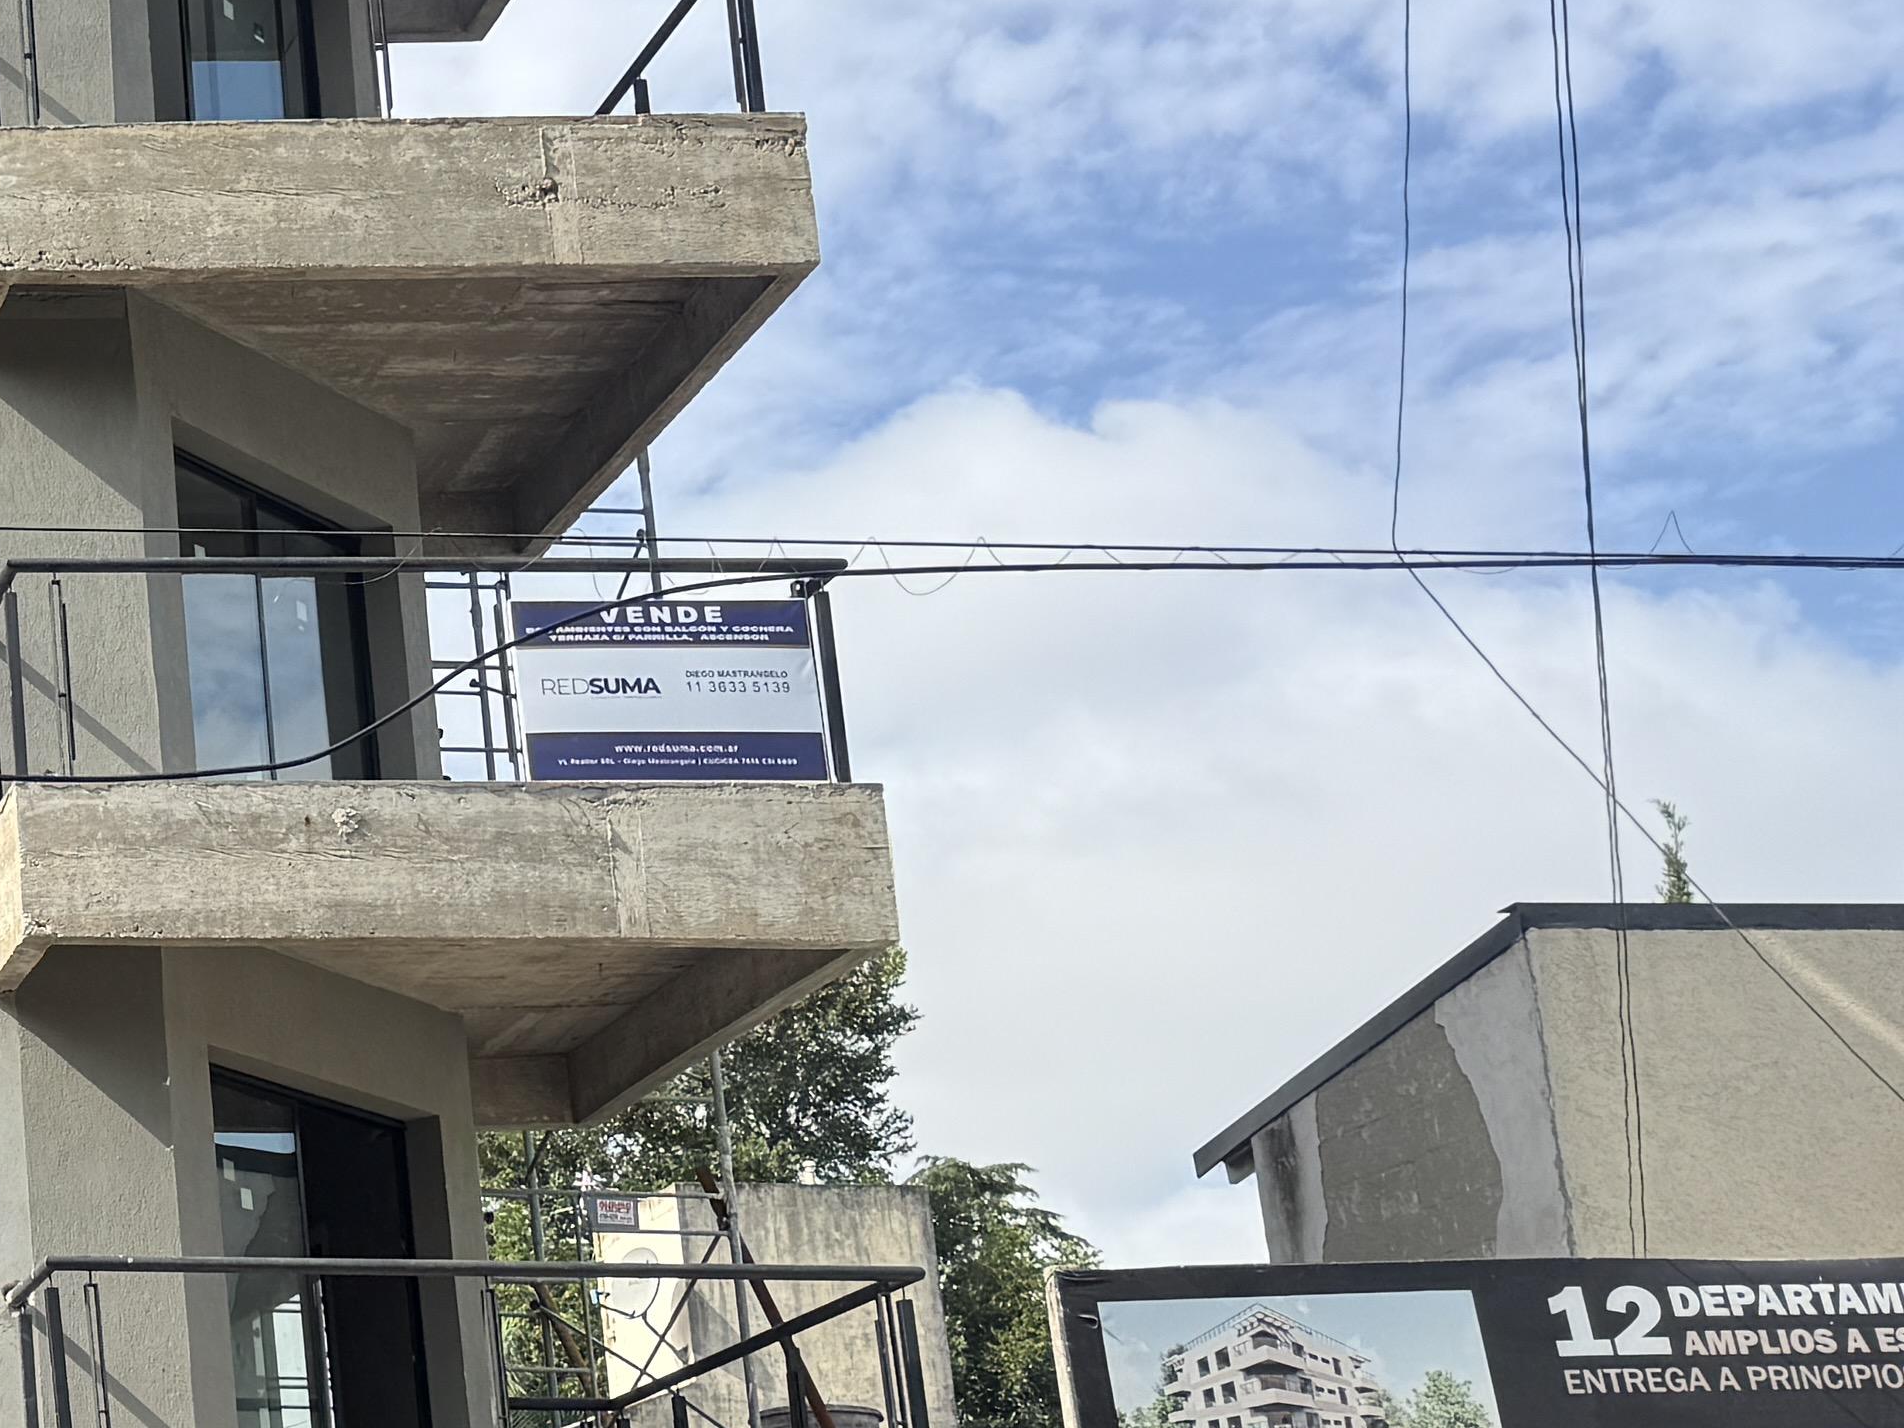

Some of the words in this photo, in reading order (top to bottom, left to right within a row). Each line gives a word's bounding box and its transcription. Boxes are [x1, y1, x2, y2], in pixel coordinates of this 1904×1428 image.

[600, 606, 723, 624] VENDE
[548, 634, 610, 642] TERRAZA
[700, 633, 770, 641] ASCENSOR
[664, 624, 717, 633] BALCÓN
[720, 625, 729, 633] Y
[731, 625, 794, 633] COCHERA
[685, 669, 715, 678] DIEGO
[541, 677, 662, 696] REDSUMA
[687, 681, 701, 693] 11
[708, 680, 747, 693] 3633
[752, 680, 791, 693] 5139
[1666, 1282, 1904, 1318] DEPARTAM
[1547, 1285, 1673, 1358] 12
[1685, 1327, 1838, 1356] AMPLIOS
[1847, 1327, 1872, 1354] A
[1564, 1366, 1712, 1395] ENTREGA
[1718, 1366, 1742, 1393] A
[1745, 1363, 1904, 1392] PRINCIPIO
